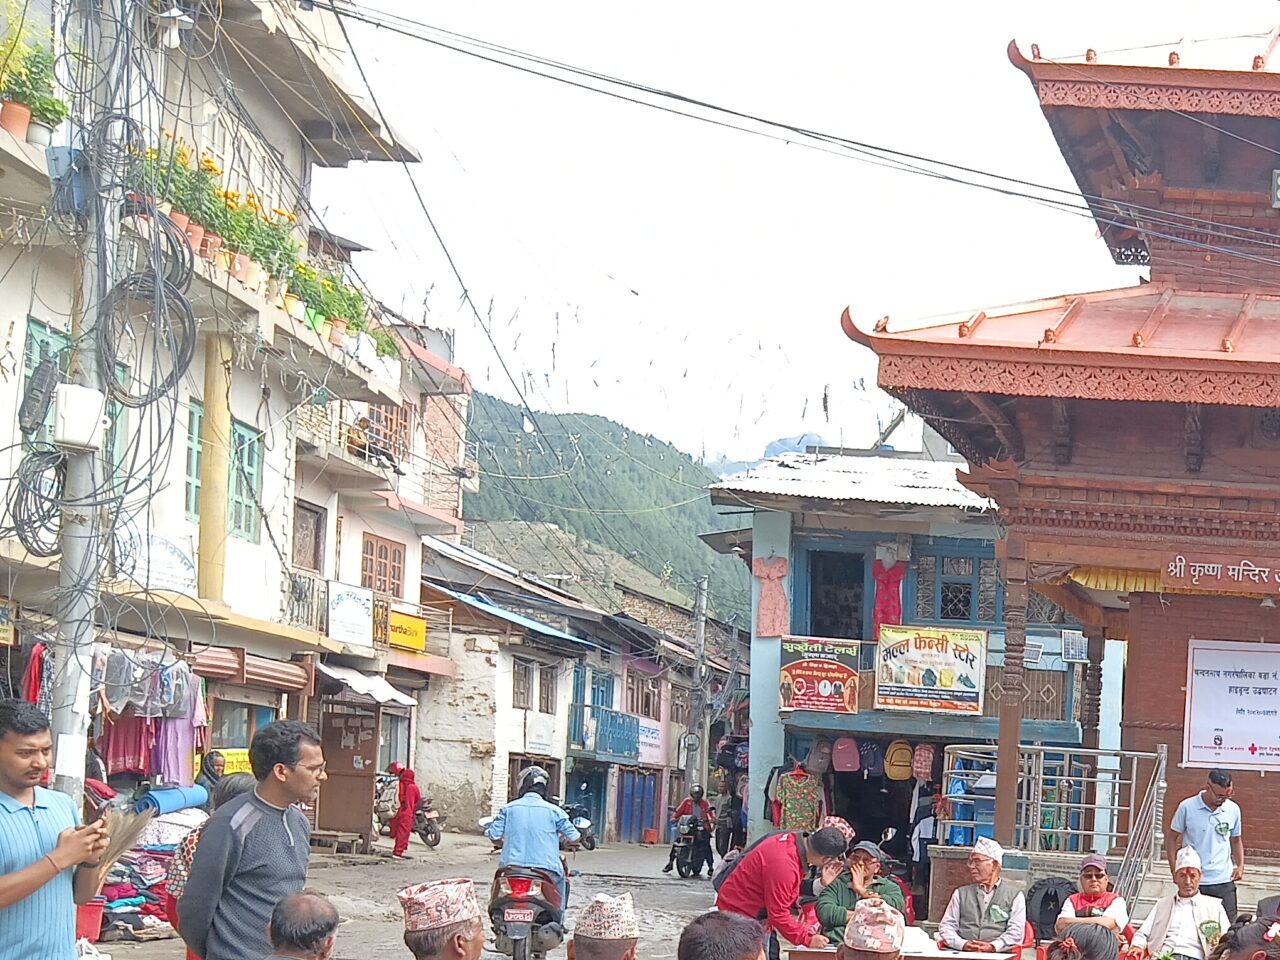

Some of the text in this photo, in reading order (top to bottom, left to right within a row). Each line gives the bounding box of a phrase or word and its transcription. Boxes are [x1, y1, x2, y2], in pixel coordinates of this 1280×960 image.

[1168, 555, 1186, 578] श्री
[1189, 562, 1223, 584] कृष्ण
[1227, 560, 1270, 583] मन्दिर
